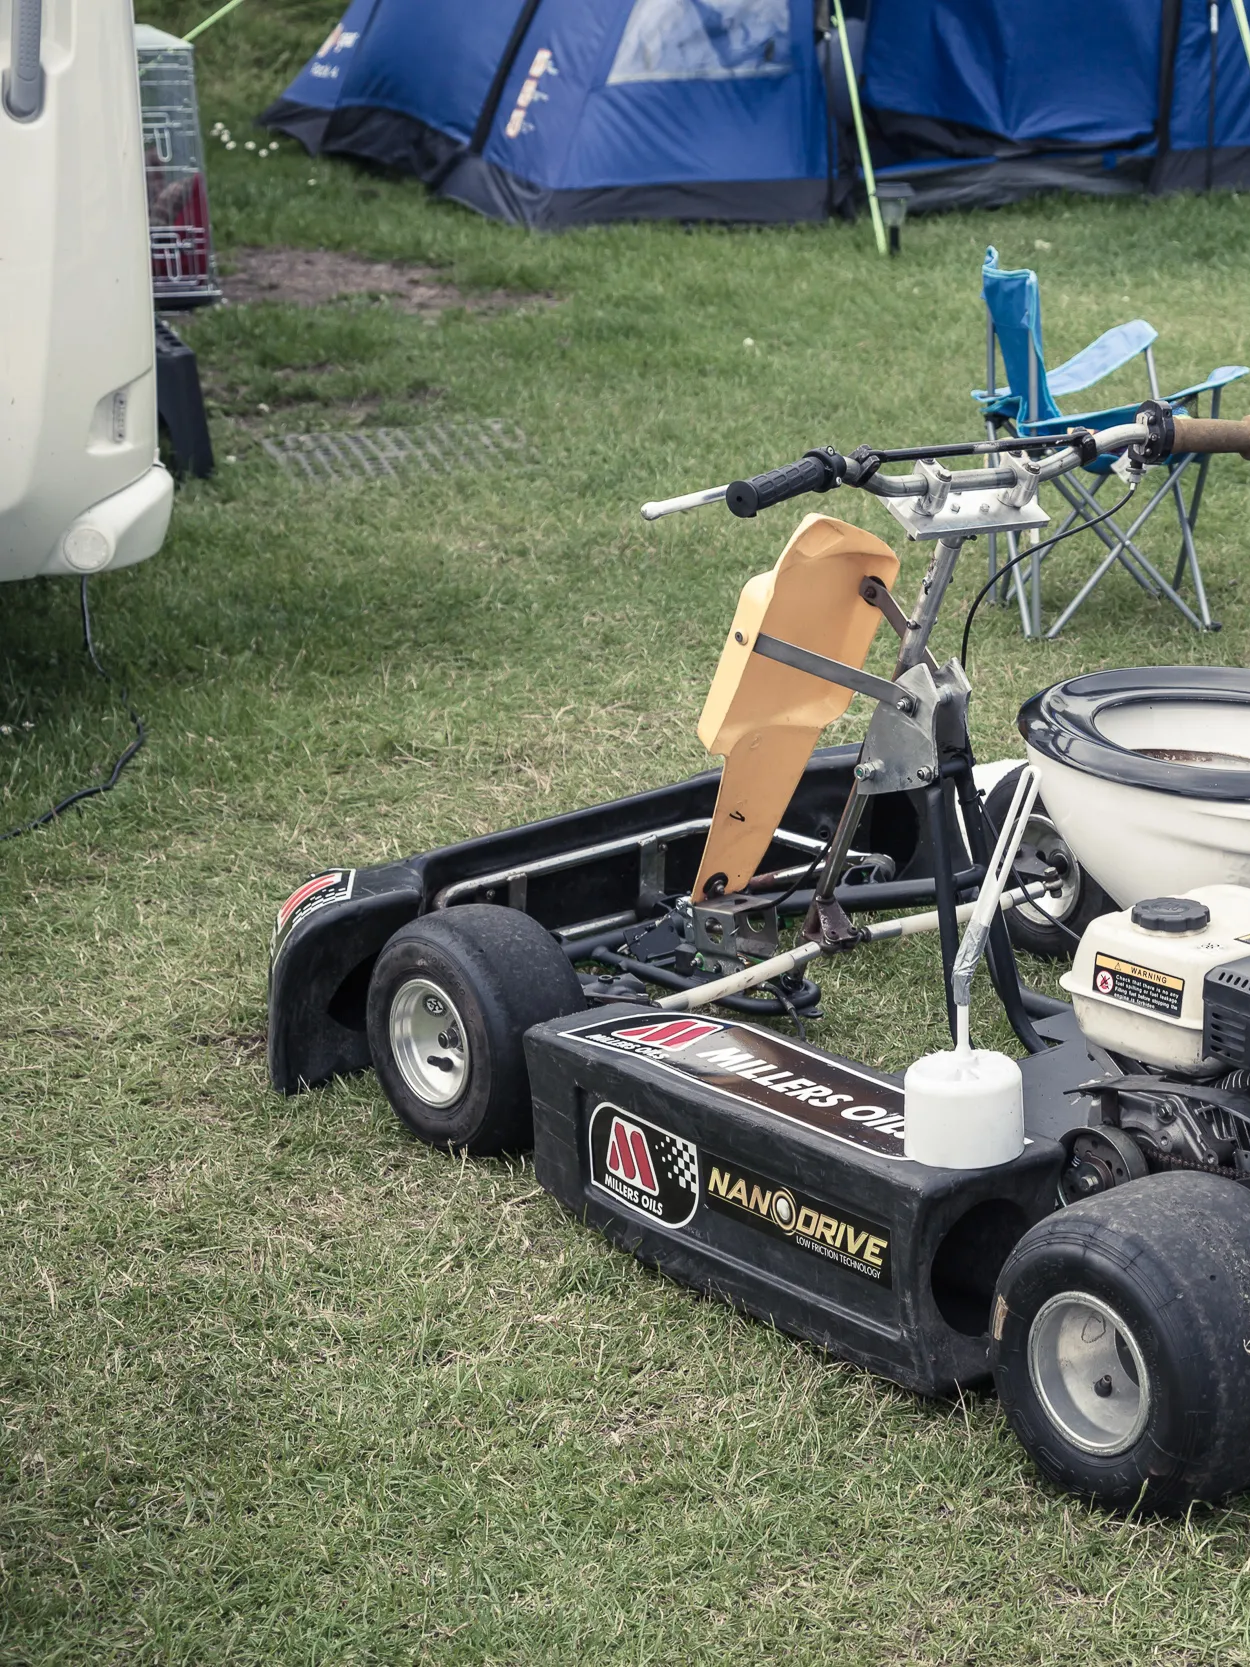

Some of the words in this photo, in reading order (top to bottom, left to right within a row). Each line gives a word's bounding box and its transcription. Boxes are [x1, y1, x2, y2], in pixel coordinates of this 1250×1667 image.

[1116, 974, 1130, 983] Check
[1132, 978, 1142, 986] that
[1142, 982, 1154, 991] there
[1162, 988, 1168, 996] no
[1131, 966, 1167, 984] WARNING
[1116, 980, 1124, 988] fuel
[1150, 990, 1158, 998] fuel
[1170, 1002, 1178, 1010] the
[584, 1033, 641, 1050] MILLERS
[635, 1047, 670, 1060] OILS
[695, 1047, 854, 1108] MILLERS
[840, 1105, 905, 1140] OIL
[604, 1173, 639, 1204] MILLERS
[641, 1195, 663, 1216] OILS
[796, 1235, 811, 1249] LOW
[811, 1241, 839, 1261] FRICTION
[839, 1254, 881, 1280] TECHNOLOGY
